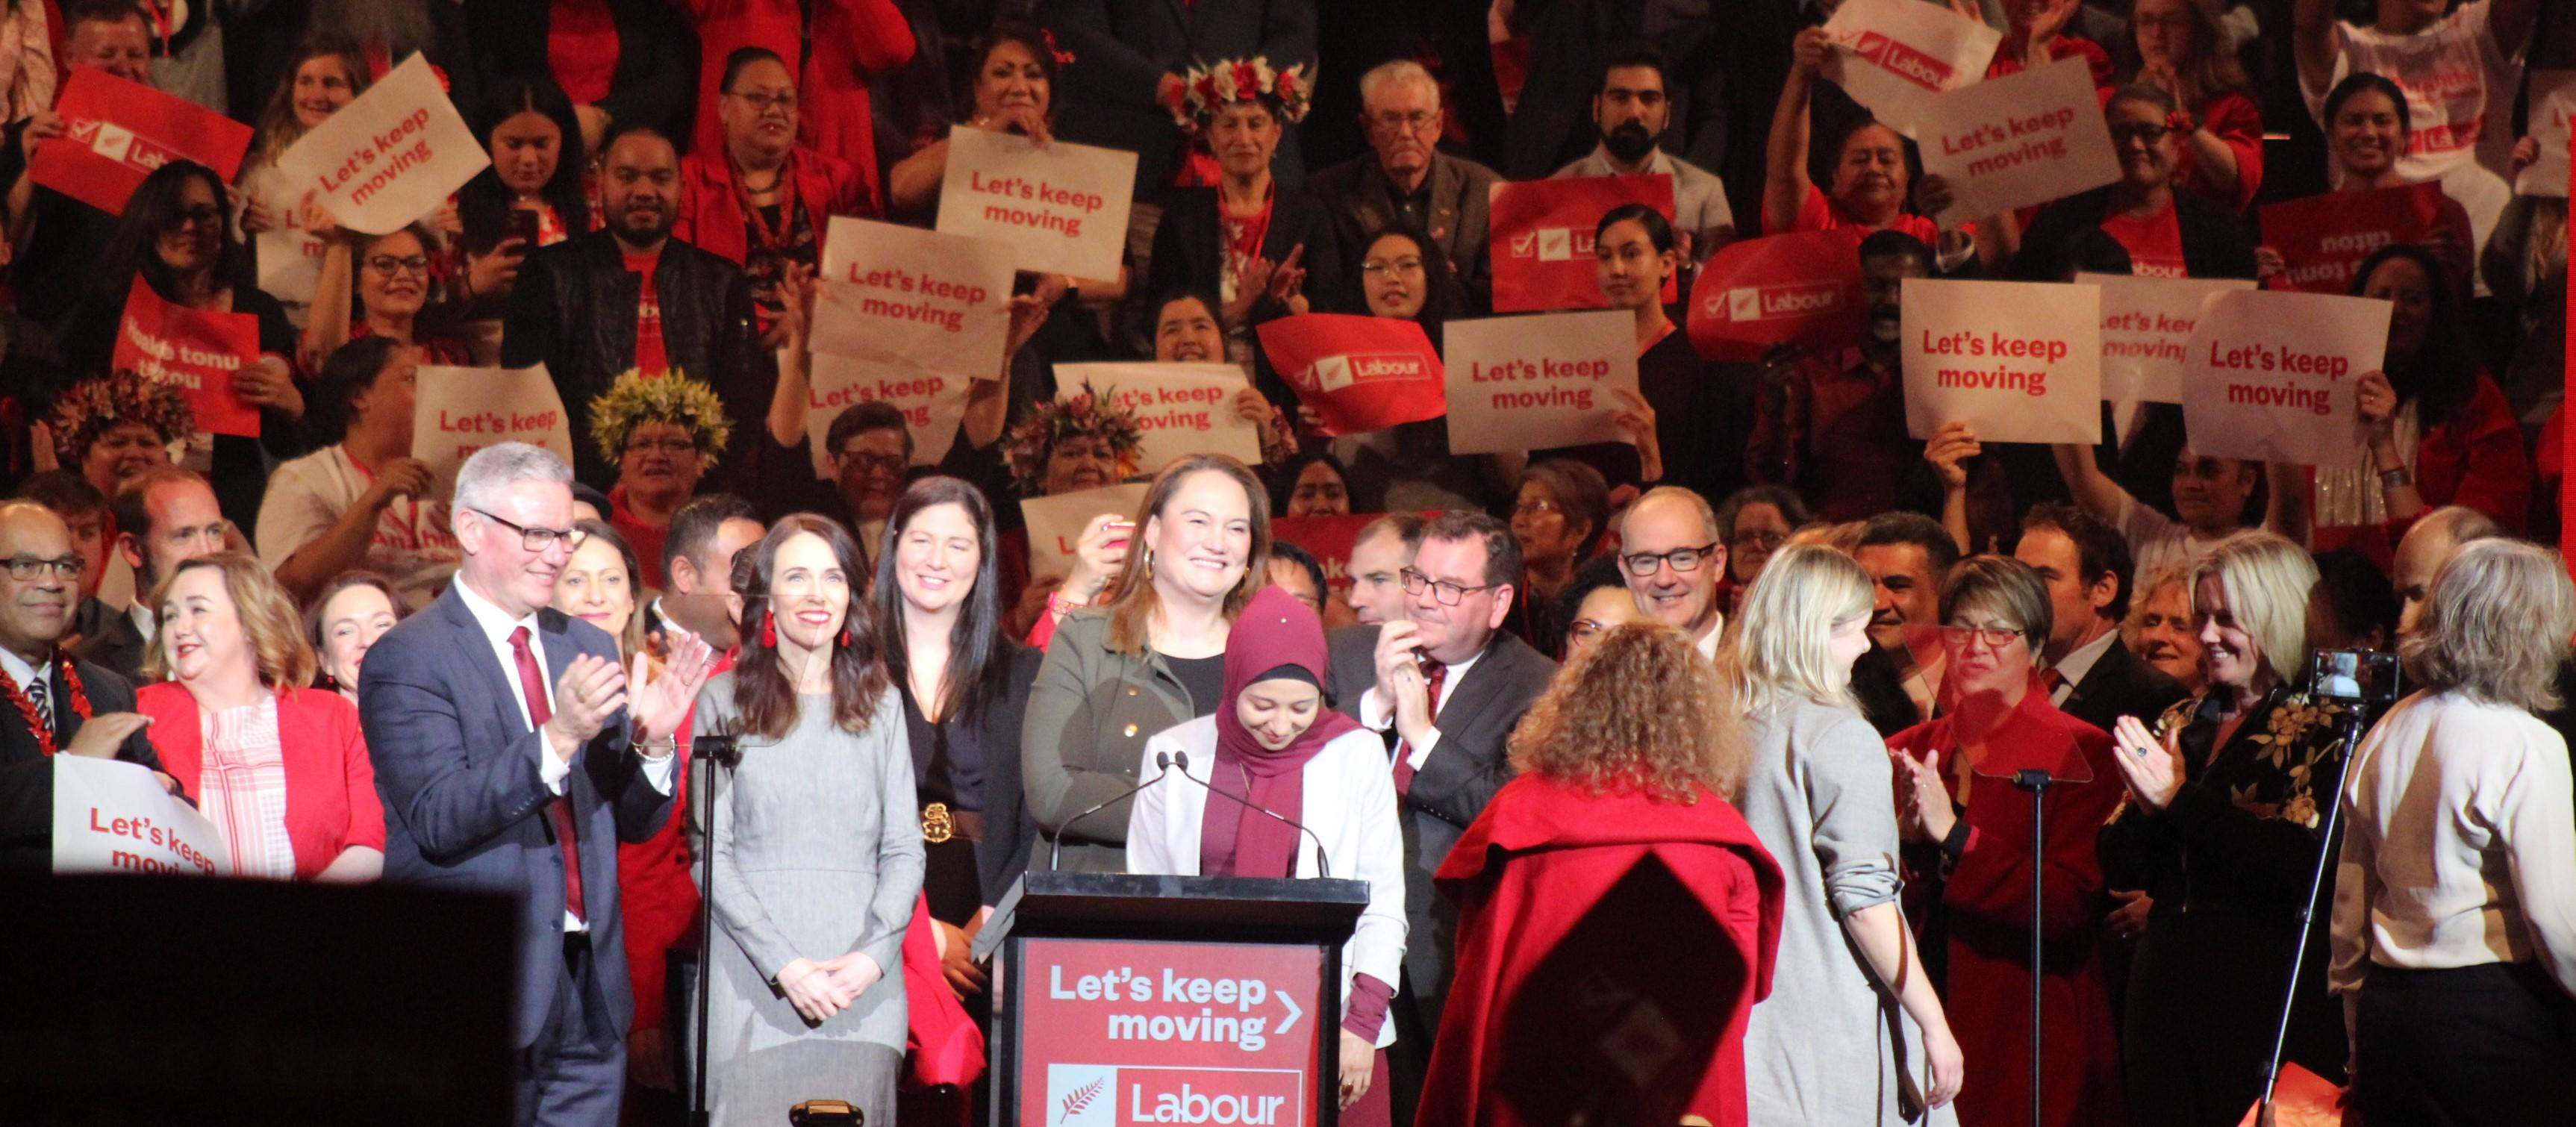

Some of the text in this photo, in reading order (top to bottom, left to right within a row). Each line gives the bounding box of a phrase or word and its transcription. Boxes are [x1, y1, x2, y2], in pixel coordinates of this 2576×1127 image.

[1887, 49, 1946, 87] Labou
[1942, 107, 2074, 155] Let's keep
[319, 107, 429, 193] Let's keep
[1967, 137, 2067, 177] moving
[352, 139, 432, 205] moving
[971, 171, 1103, 213] Let's keep
[984, 205, 1082, 238] moving
[849, 263, 986, 307] Let's keep
[862, 298, 964, 332] moving
[1765, 292, 1834, 313] Labour
[2100, 311, 2196, 333] et's ke
[180, 346, 240, 370] tonu
[1923, 330, 2067, 364] Let's keep
[2210, 340, 2348, 381] Let's keep
[1354, 360, 1420, 378] Labour
[1472, 358, 1610, 382] Let's keep
[1938, 365, 2047, 396] moving
[809, 376, 945, 409] Let's keep
[1158, 387, 1223, 405] keep
[1491, 384, 1594, 410] moving
[2228, 381, 2331, 416] moving
[439, 410, 558, 434] Let's keep
[1138, 410, 1212, 431] oving
[91, 808, 216, 876] Let's keep
[1050, 965, 1267, 1012] Let's keep
[1108, 1008, 1267, 1052] moving
[1132, 1084, 1285, 1126] Labour
